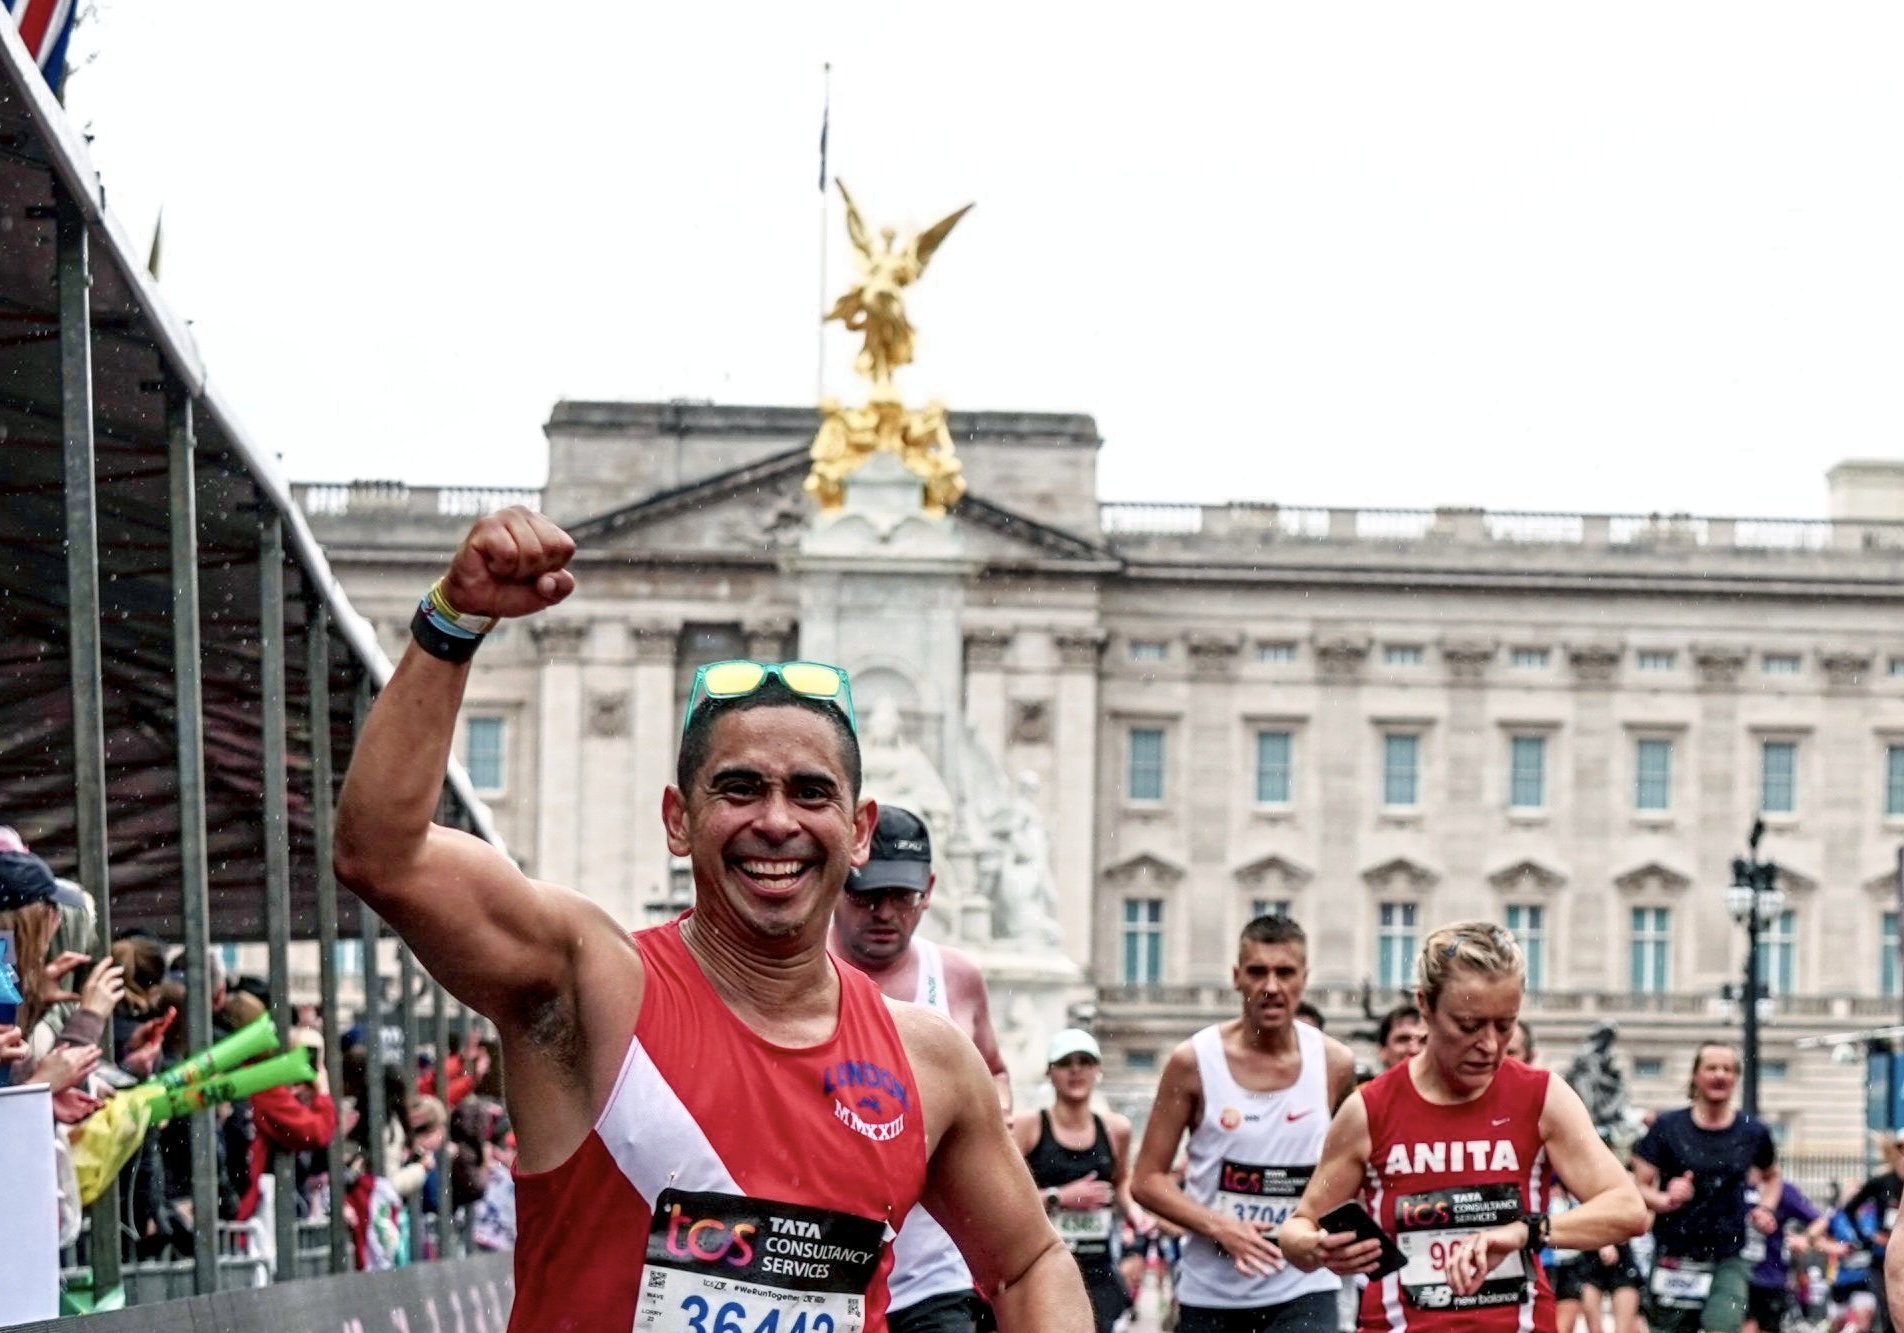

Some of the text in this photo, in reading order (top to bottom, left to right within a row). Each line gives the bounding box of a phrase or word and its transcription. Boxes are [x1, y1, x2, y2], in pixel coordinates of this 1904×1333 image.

[823, 1060, 910, 1112] LONDON
[834, 1098, 904, 1141] MMXXIII
[1384, 1140, 1520, 1175] ANITA
[1452, 1192, 1482, 1203] TATA
[1233, 1203, 1298, 1224] 3704
[1402, 1201, 1450, 1227] tcs
[666, 1203, 757, 1267] tcs
[769, 1216, 821, 1240] TATA
[765, 1236, 874, 1265] CONSULTANCY
[761, 1256, 830, 1279] SERVICES
[734, 1284, 800, 1302] #WeRunTogether
